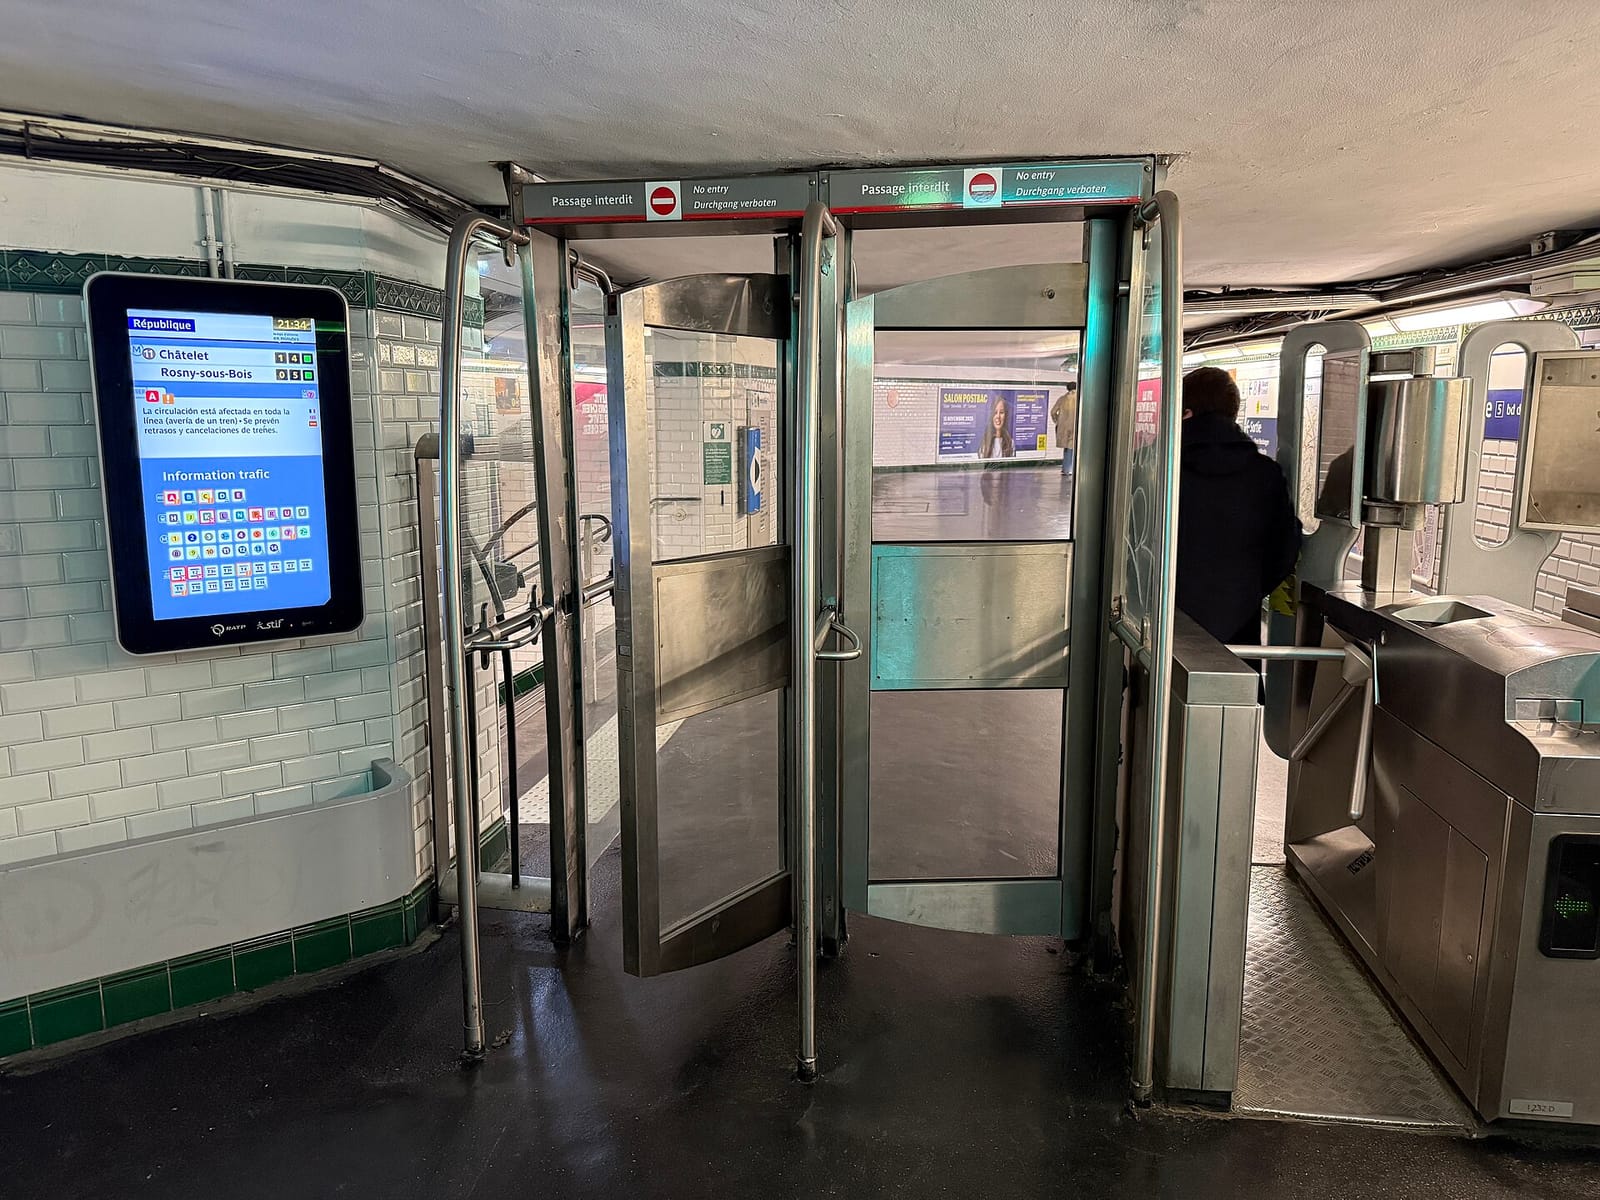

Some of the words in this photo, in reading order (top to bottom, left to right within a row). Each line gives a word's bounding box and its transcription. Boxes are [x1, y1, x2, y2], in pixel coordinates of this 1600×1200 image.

[1015, 170, 1030, 181] No
[1031, 170, 1056, 181] entry
[693, 185, 706, 195] No
[707, 184, 729, 195] entry
[861, 184, 905, 197] Passage
[908, 181, 950, 193] interdit
[1015, 185, 1065, 197] Durchgang
[1066, 184, 1107, 195] verboten
[552, 196, 592, 208] Passage
[595, 194, 633, 206] interdit
[693, 199, 739, 211] Durchgang
[740, 198, 777, 208] verboten
[133, 319, 192, 332] République
[277, 319, 306, 330] 21:34
[159, 350, 209, 361] Châtelet
[161, 367, 252, 381] Rosny-sous-Bois
[142, 407, 152, 415] La
[154, 407, 199, 415] circulación
[200, 407, 217, 415] está
[218, 407, 252, 415] afectada
[1506, 403, 1516, 416] bd
[143, 417, 165, 425] línea
[165, 417, 193, 426] (avería
[194, 417, 205, 425] de
[243, 417, 253, 425] Se
[254, 417, 280, 426] prevén
[144, 427, 177, 435] retrasos
[178, 428, 184, 436] y
[185, 426, 240, 435] cancelaciones
[241, 426, 251, 434] de
[163, 469, 236, 482] Information
[239, 469, 270, 481] trafic
